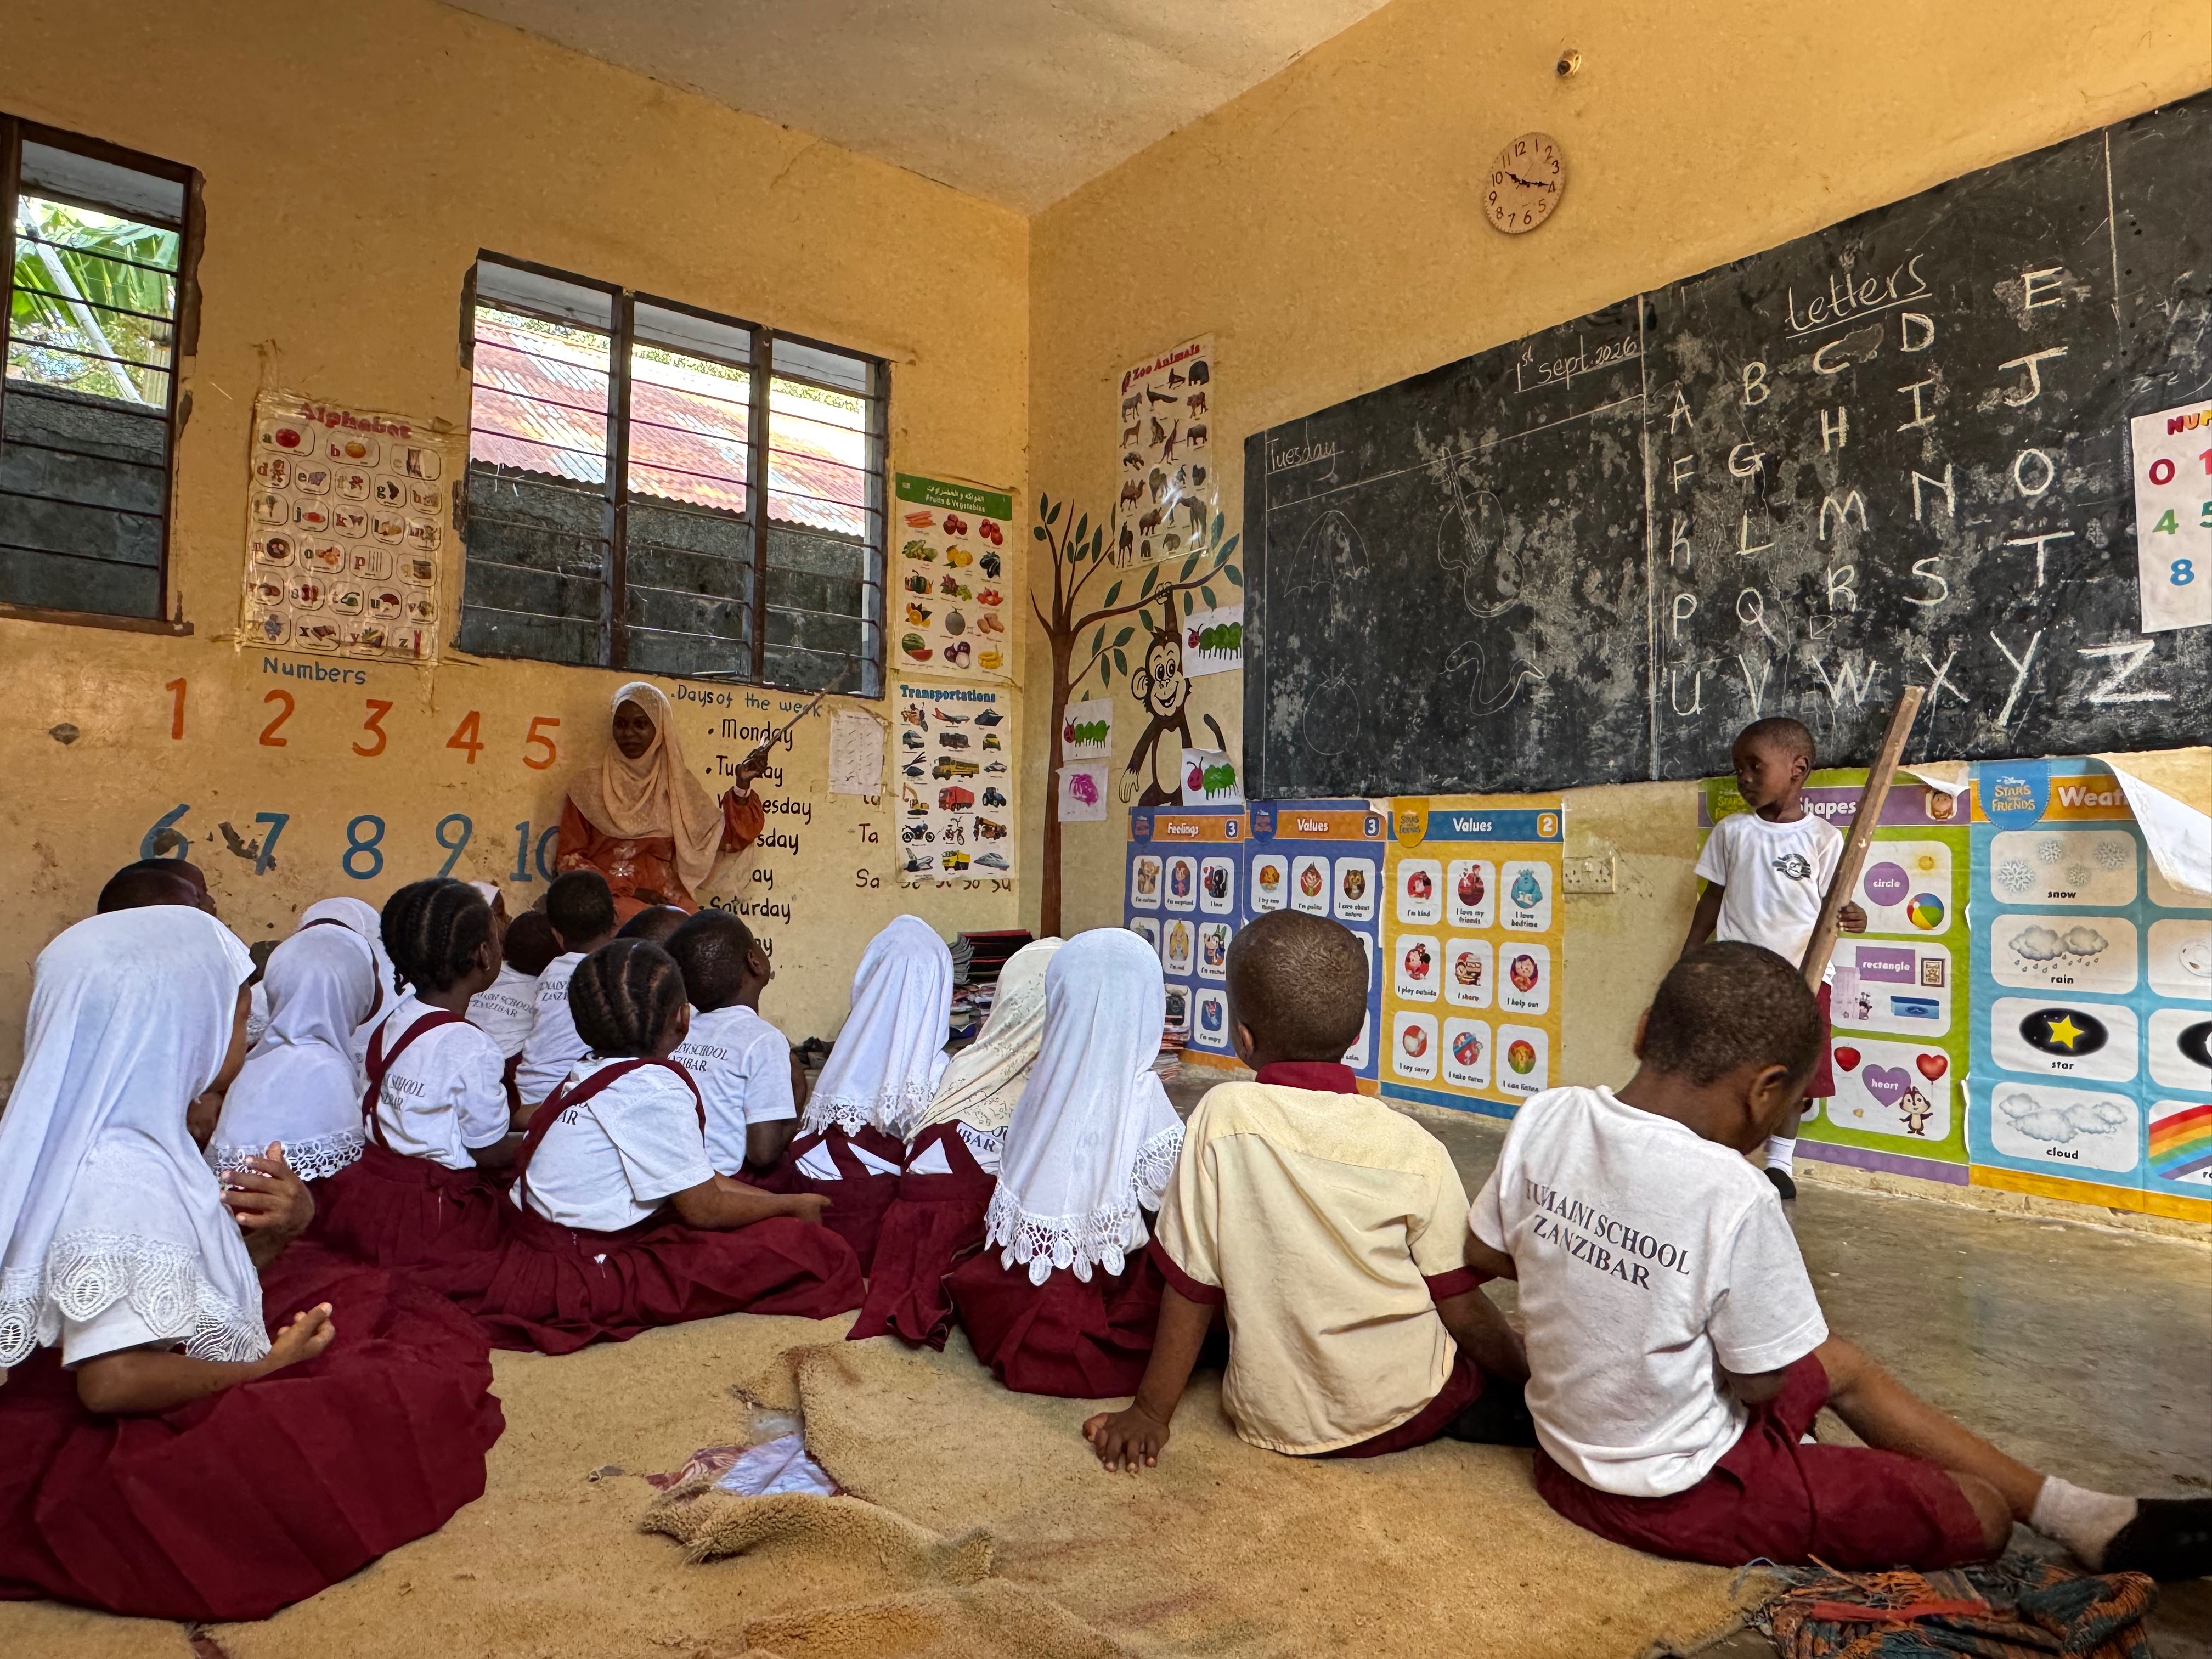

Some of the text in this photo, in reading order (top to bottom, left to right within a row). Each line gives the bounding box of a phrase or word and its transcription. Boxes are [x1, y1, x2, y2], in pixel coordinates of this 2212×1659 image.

[1515, 141, 1526, 157] 12
[1535, 138, 1538, 152] 1
[1502, 153, 1510, 168] 11
[1544, 145, 1553, 162] 2
[1551, 160, 1559, 174] 3
[1492, 171, 1503, 187] 10
[1547, 180, 1556, 193] 4
[1489, 191, 1497, 205] 9
[1538, 199, 1546, 212] 5
[1496, 206, 1504, 219] 8
[1508, 213, 1515, 227] 7
[1523, 210, 1532, 224] 6
[1671, 267, 2063, 435] A B C D E
[1132, 343, 1200, 381] Zoo Animals
[1669, 346, 2068, 494] F G H I J
[331, 443, 341, 457] b
[1266, 420, 1335, 481] Tuesday
[257, 462, 268, 476] d
[297, 472, 307, 482] e
[2149, 459, 2175, 486] 0
[376, 486, 386, 499] g
[413, 490, 422, 504] h
[294, 507, 301, 523] j
[1671, 448, 2054, 568] K L M N O
[2152, 509, 2179, 535] 4
[304, 549, 314, 559] o
[354, 556, 366, 570] p
[2170, 558, 2194, 586] 8
[1672, 531, 2075, 647] P Q R S T
[399, 638, 409, 647] z
[263, 657, 367, 685] Numbers
[1672, 630, 2172, 726] U V W X Y Z
[744, 692, 771, 710] the
[900, 684, 996, 703] Transportations
[165, 677, 561, 770] 1 2 3 4 5
[722, 719, 793, 752] Monday
[716, 755, 783, 787] Tuay
[1167, 822, 1199, 838] Feelings
[1228, 821, 1236, 837] 3
[1296, 818, 1376, 834] Values 3
[1453, 817, 1553, 832] Values 2
[858, 823, 878, 843] Ta
[139, 803, 190, 860] 6
[253, 812, 290, 876] 7
[342, 814, 386, 880] 8
[435, 814, 473, 878] 9
[757, 827, 798, 856] sday
[856, 868, 880, 889] Sa
[1872, 879, 1900, 888] circle
[2047, 890, 2076, 899] snow
[1862, 961, 1910, 972] rectangle
[2051, 973, 2074, 984] rain
[2051, 1060, 2074, 1070] star
[1871, 1078, 1899, 1090] heart
[2046, 1147, 2079, 1159] cloud
[1533, 1214, 1650, 1290] ZANZIBAR
[1594, 1214, 1690, 1275] SCHOOL
